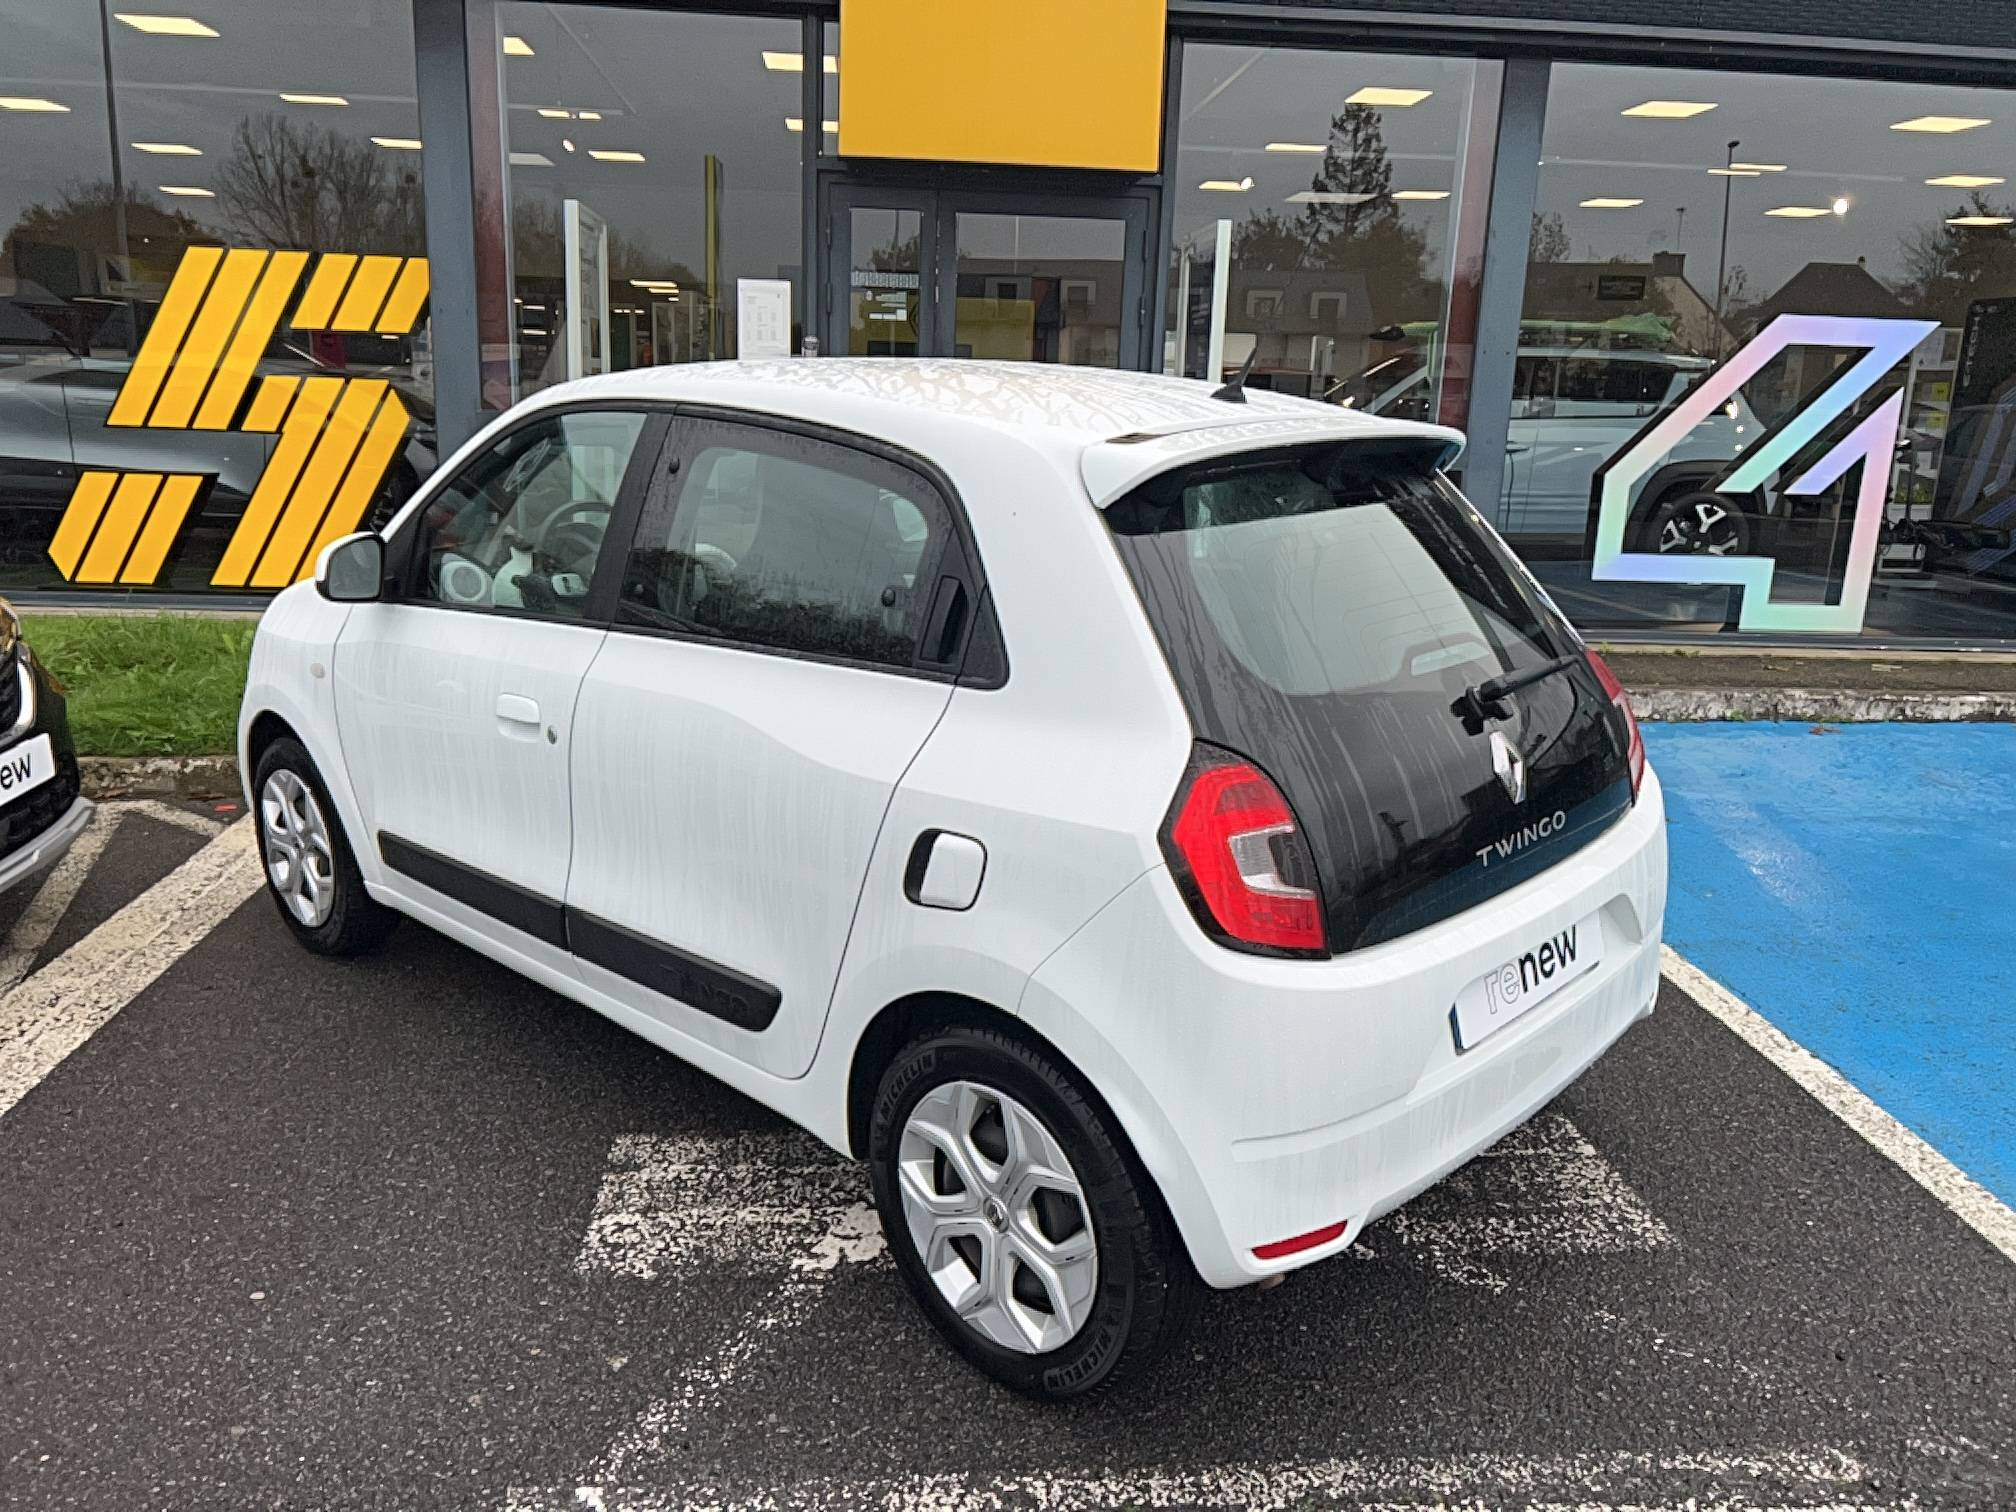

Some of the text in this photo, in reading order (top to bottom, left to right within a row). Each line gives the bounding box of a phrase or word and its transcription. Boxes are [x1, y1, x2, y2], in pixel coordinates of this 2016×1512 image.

[1476, 810, 1566, 868] TWINGO
[1484, 924, 1576, 1014] renew
[880, 1053, 933, 1120] MICHELIN
